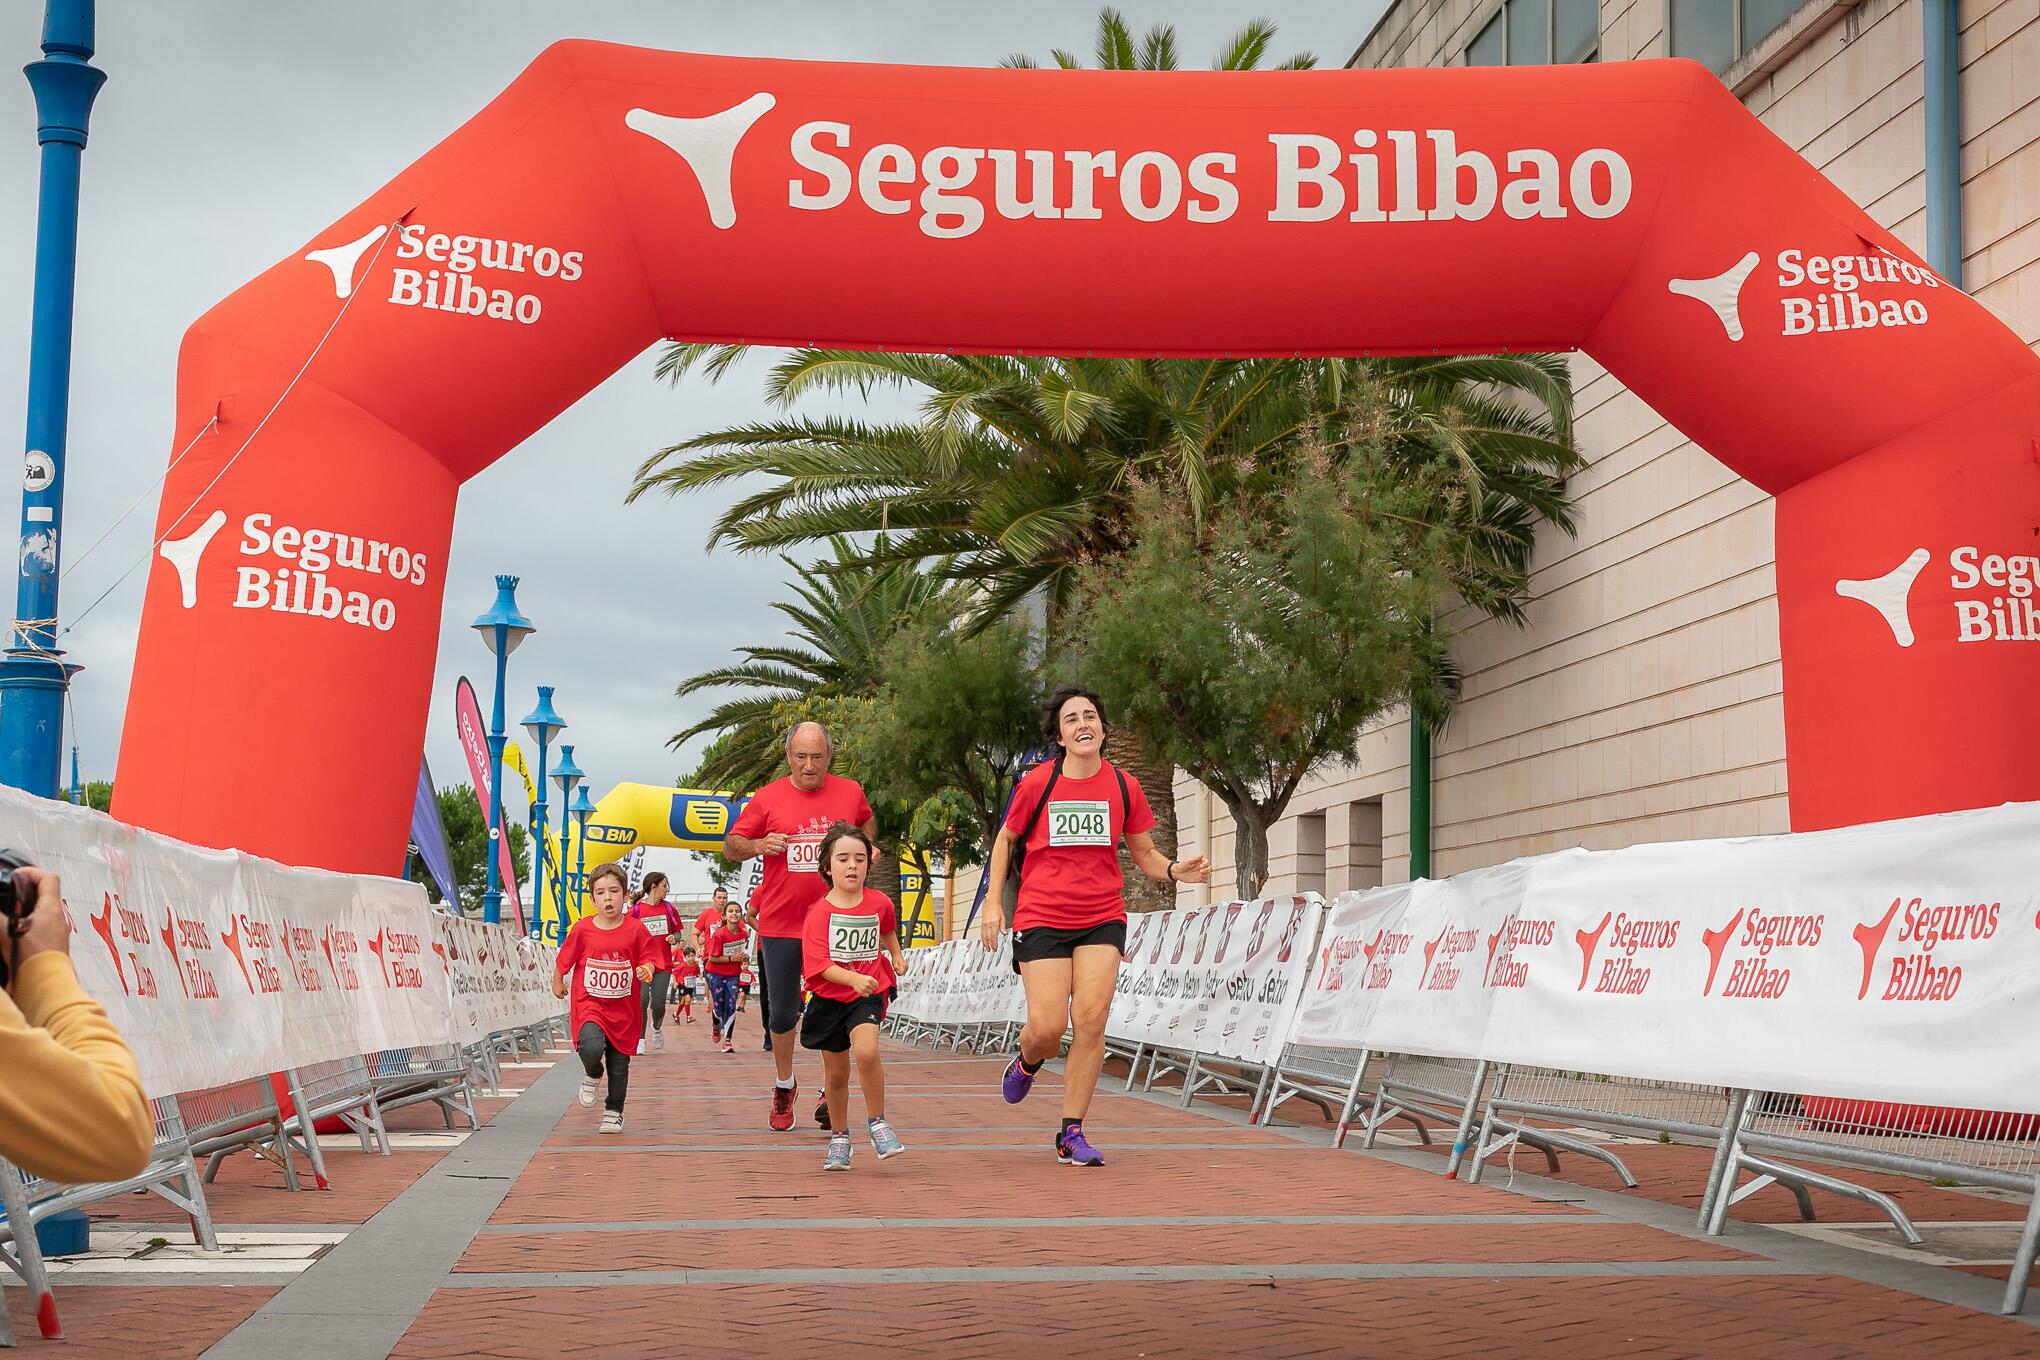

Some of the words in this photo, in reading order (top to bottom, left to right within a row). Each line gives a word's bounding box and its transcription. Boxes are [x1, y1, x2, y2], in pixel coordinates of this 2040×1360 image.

[788, 121, 1238, 239] Seguros
[1267, 128, 1632, 223] Bilbao
[396, 224, 584, 281] Seguros
[1776, 248, 1939, 291] Seguros
[387, 268, 543, 325] Bilbao
[1780, 292, 1928, 336] Bilbao
[239, 512, 427, 586] Seguros
[232, 566, 396, 632] Bilbao
[606, 828, 634, 843] BM
[1056, 813, 1105, 835] 2048
[834, 927, 878, 951] 2048
[1440, 925, 1480, 961] Seguros
[1502, 913, 1556, 952] Seguros
[1610, 912, 1680, 956] Seguros
[1741, 907, 1825, 956] Seguros
[1898, 897, 2001, 952] Seguros
[589, 969, 629, 990] 3008
[1427, 961, 1464, 991] Bilbao
[1490, 953, 1529, 989] Bilbao
[1594, 957, 1651, 995] Bilbao
[1722, 956, 1791, 999] Bilbao
[1881, 953, 1962, 1002] Bilbao
